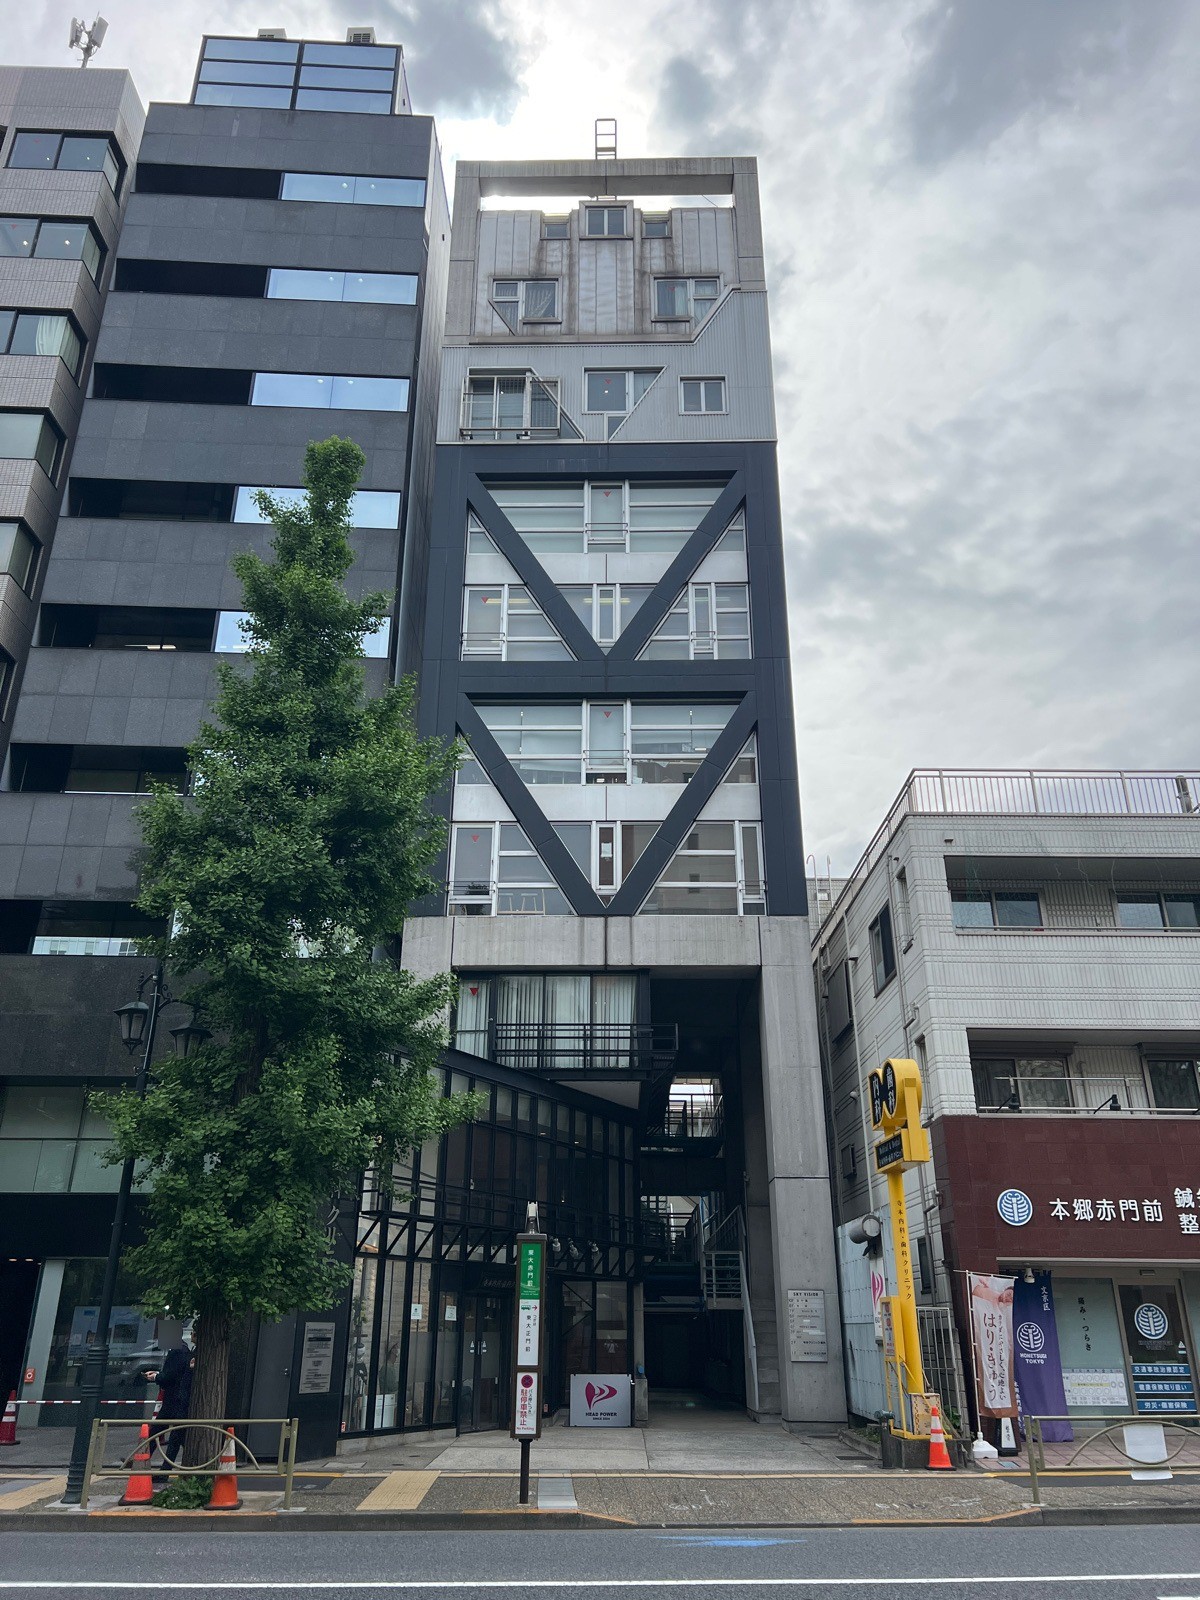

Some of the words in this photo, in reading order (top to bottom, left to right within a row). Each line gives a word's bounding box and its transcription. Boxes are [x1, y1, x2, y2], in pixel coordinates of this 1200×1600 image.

[1049, 1198, 1163, 1222] 本郷赤門前
[527, 1249, 535, 1287] 東大赤門前
[896, 1200, 912, 1301] 寺本内科・歯科クリニック
[1040, 1286, 1051, 1311] 文京区
[983, 1313, 998, 1402] はり・きゅう
